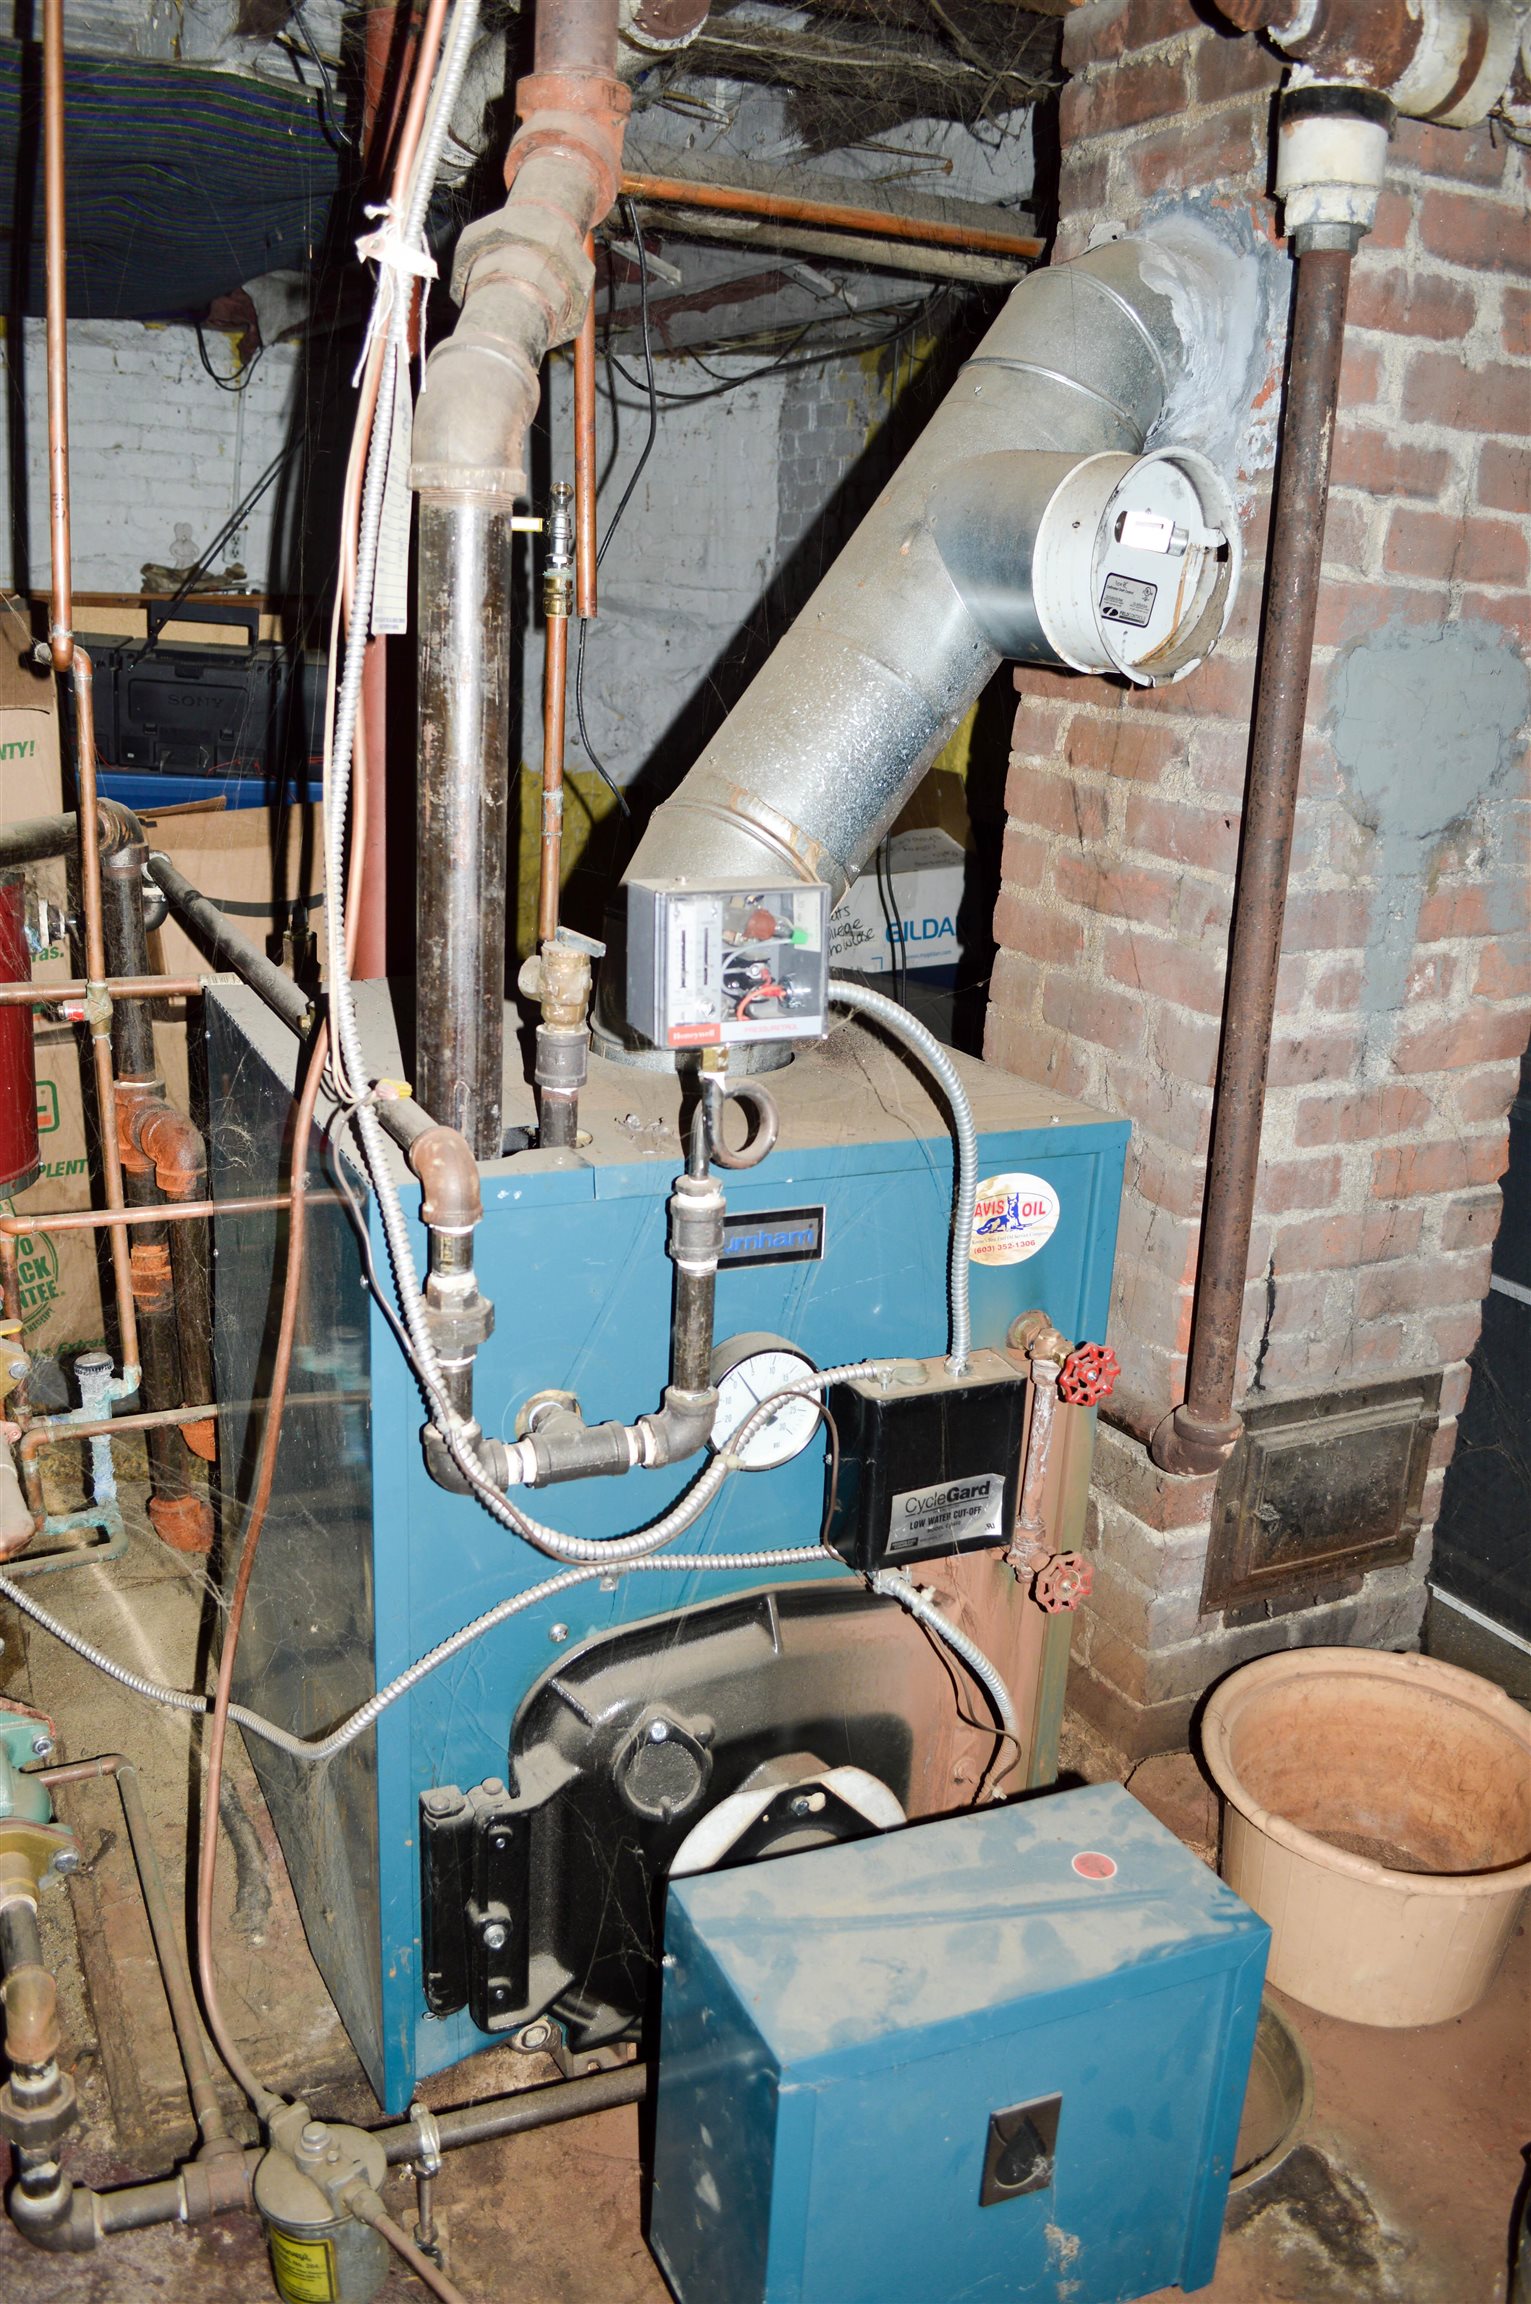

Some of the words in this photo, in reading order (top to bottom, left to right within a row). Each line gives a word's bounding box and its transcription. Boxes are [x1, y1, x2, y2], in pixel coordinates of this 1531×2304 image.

[168, 694, 224, 709] SONY
[673, 1029, 716, 1041] Honeywell
[1022, 1201, 1046, 1217] OIL
[974, 1245, 995, 1254] (603)
[997, 1239, 1036, 1250] 352-1306
[905, 1481, 990, 1514] CycleGard
[910, 1520, 925, 1530] LOW
[928, 1512, 951, 1525] WATER
[953, 1506, 983, 1519] CUT-OFF
